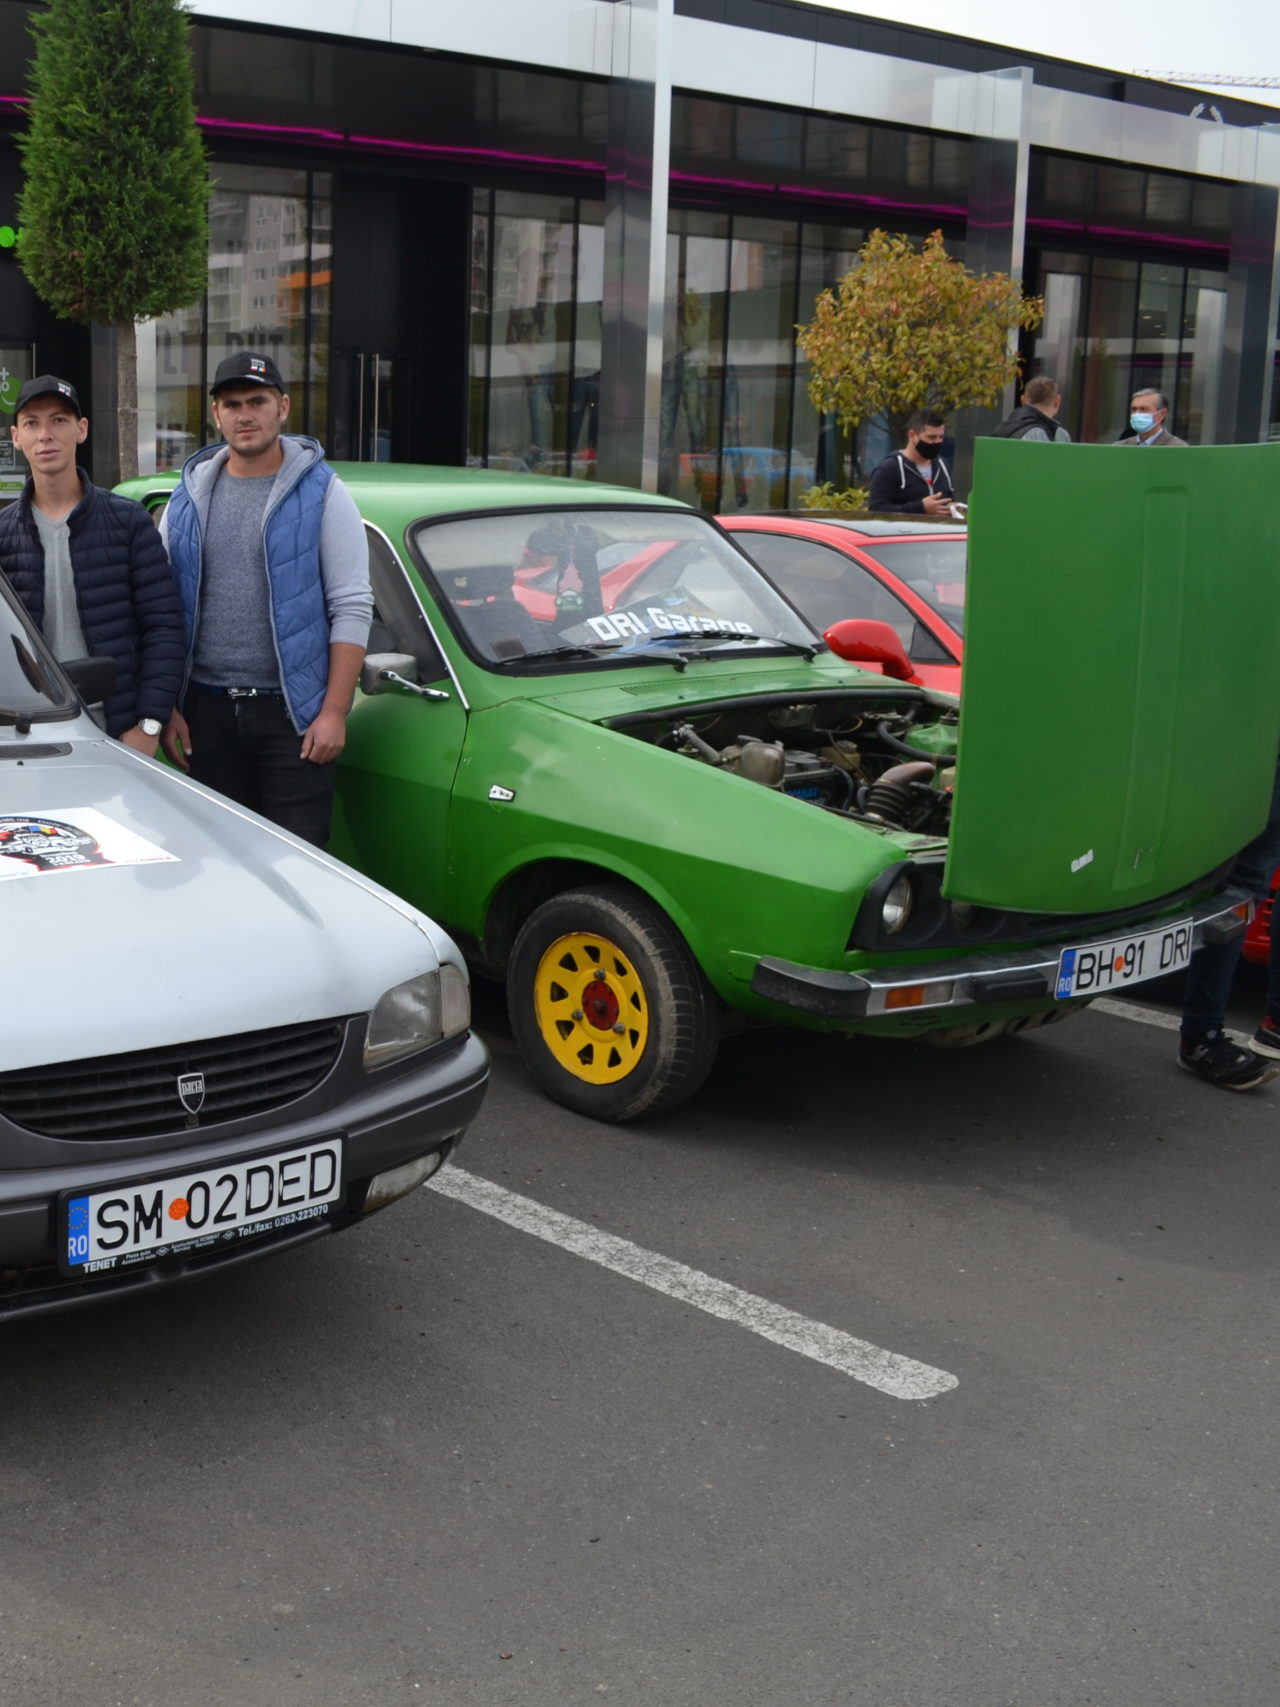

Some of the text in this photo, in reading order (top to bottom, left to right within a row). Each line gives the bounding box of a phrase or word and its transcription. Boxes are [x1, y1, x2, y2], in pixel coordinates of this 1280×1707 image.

[587, 612, 650, 641] DRI
[1075, 925, 1192, 990] BH 91 DRI
[1058, 976, 1071, 993] RO
[96, 1189, 164, 1251] SM
[275, 1204, 329, 1228] 0262-223070
[68, 1234, 89, 1258] RO
[83, 1257, 118, 1274] TENET
